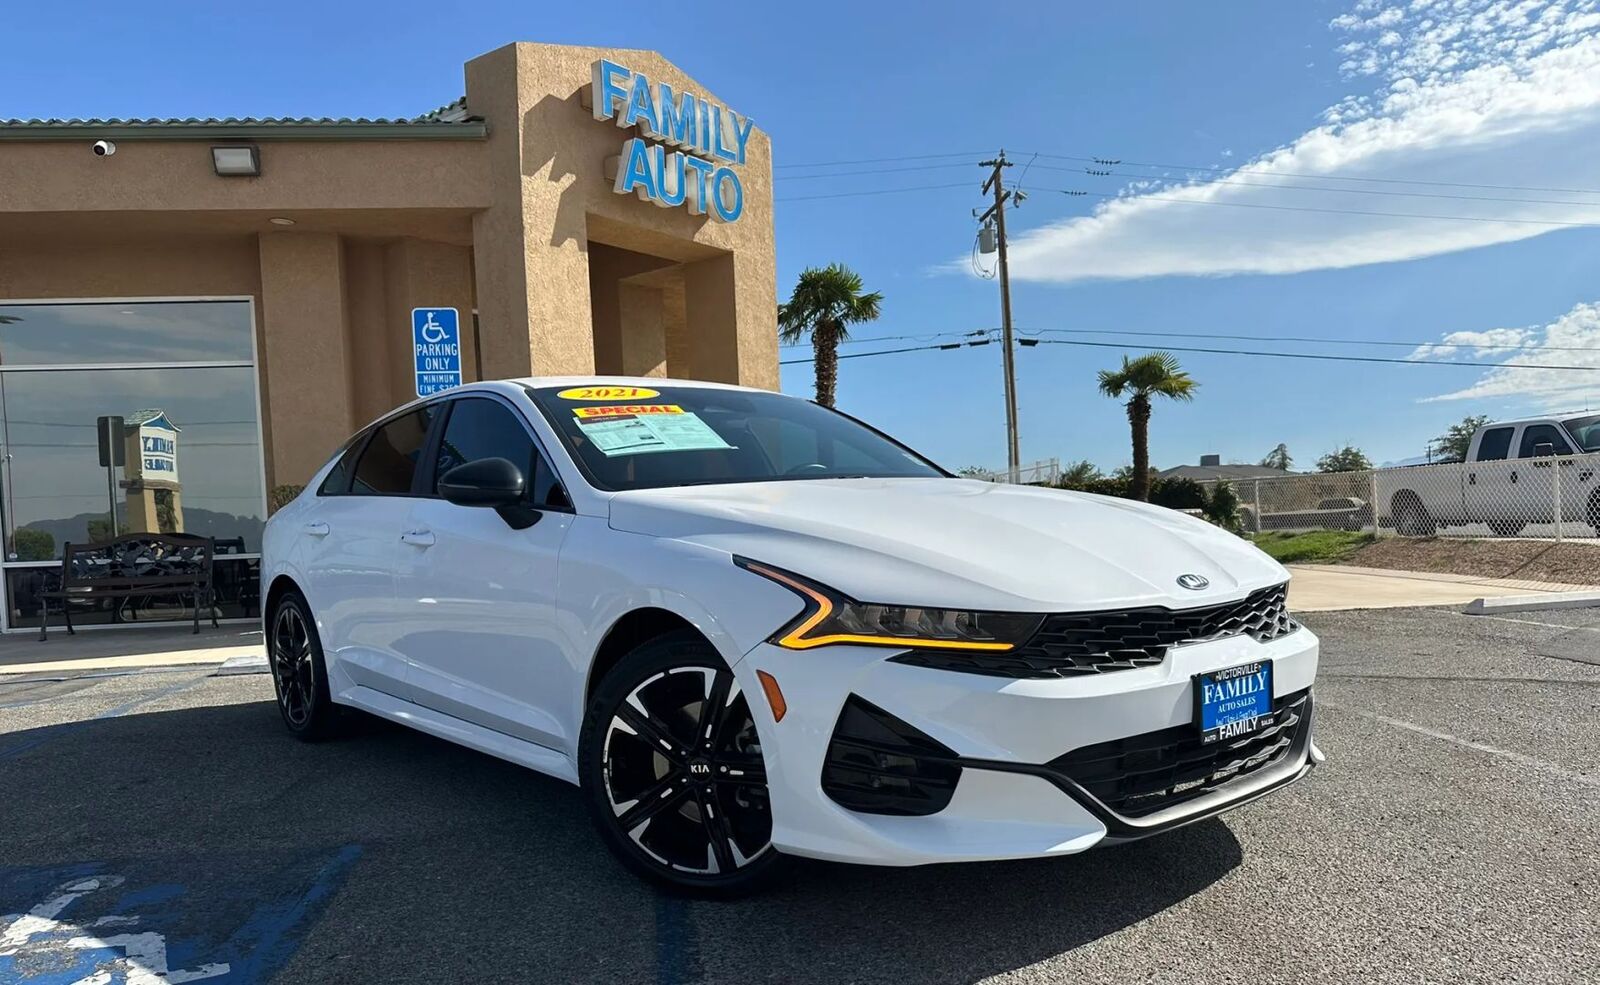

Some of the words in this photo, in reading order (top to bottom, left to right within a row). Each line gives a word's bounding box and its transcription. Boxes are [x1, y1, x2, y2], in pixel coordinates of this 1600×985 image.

[592, 58, 754, 166] FAMILY
[615, 137, 743, 223] AUTO
[416, 343, 457, 356] PARKING
[425, 357, 450, 370] ONLY
[423, 374, 455, 384] MINIMUM
[419, 384, 436, 394] FINE
[579, 388, 638, 399] 2021
[583, 405, 677, 416] SPECIAL
[1217, 663, 1259, 680] VICTORVILLE
[1203, 671, 1268, 705] FAMILY
[1217, 700, 1236, 714] AUTO
[1236, 696, 1257, 709] SALES
[1219, 717, 1258, 740] FAMILY
[690, 764, 710, 773] KIA
